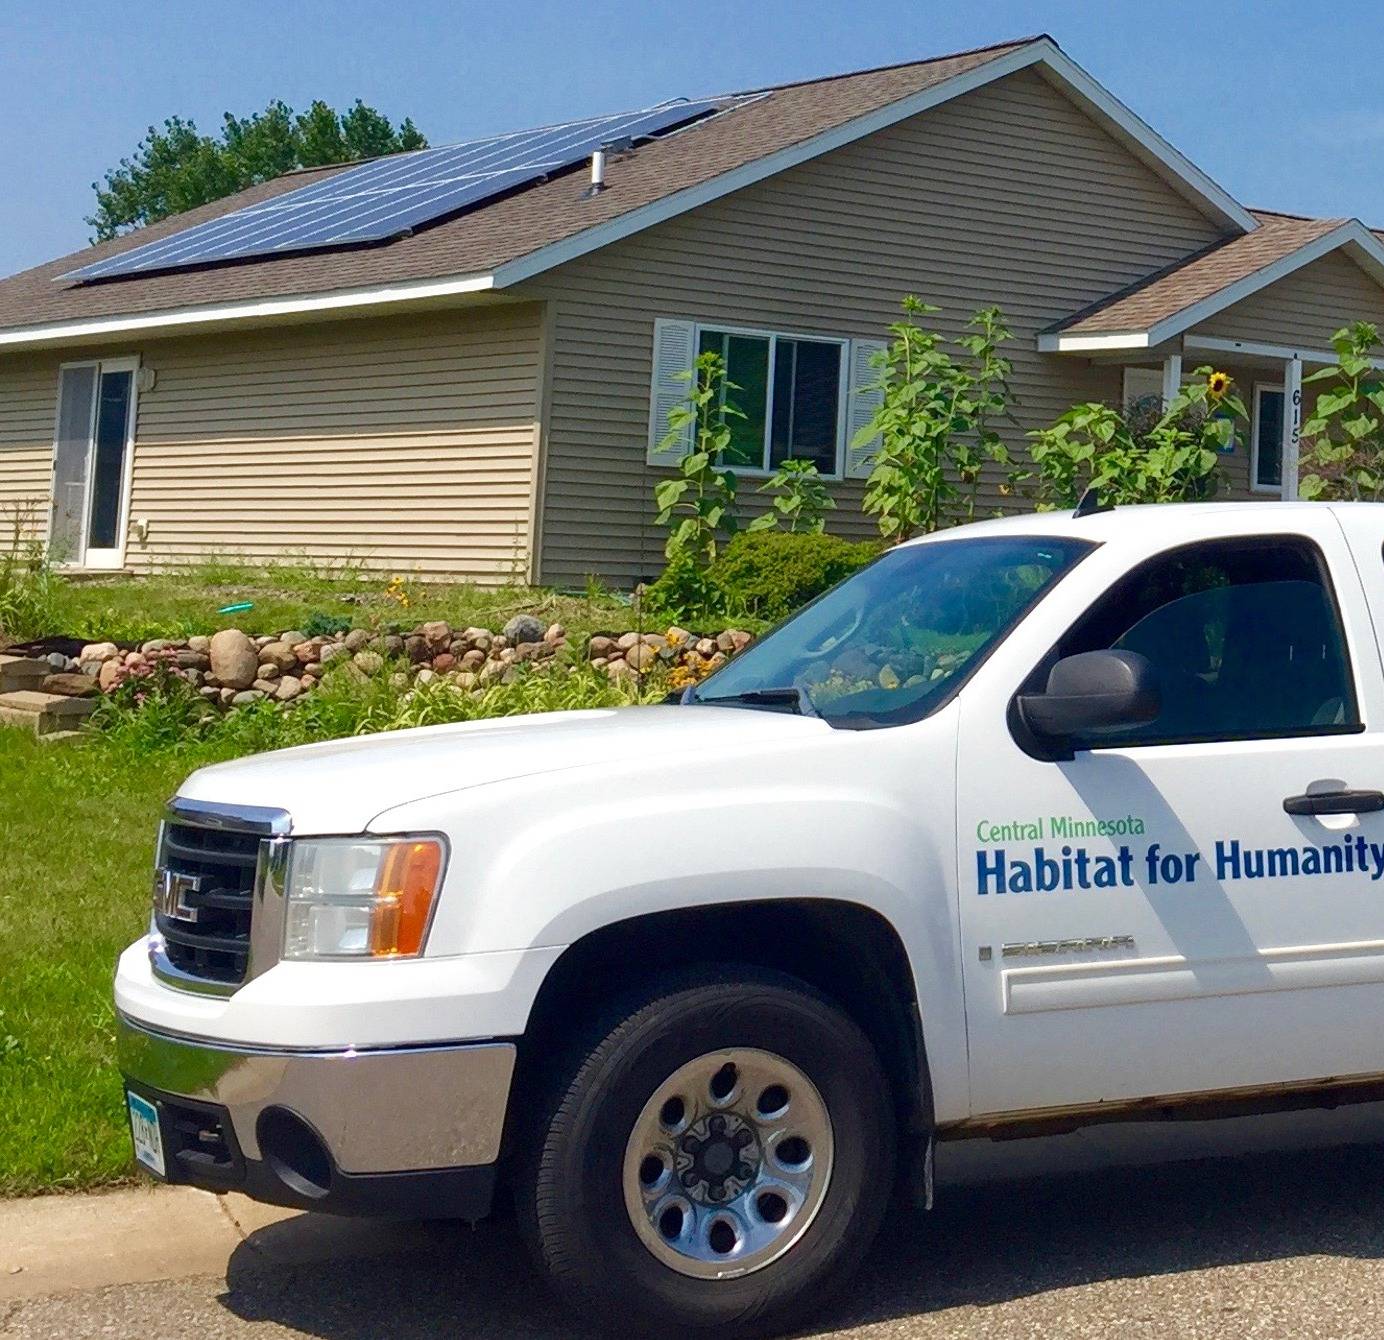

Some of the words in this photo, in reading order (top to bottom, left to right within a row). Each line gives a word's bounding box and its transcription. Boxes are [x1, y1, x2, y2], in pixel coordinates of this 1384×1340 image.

[1291, 389, 1301, 444] 615
[976, 818, 1043, 843] Central
[1050, 814, 1146, 839] Minnesota
[976, 845, 1135, 895] Habitat
[1145, 843, 1201, 884] for
